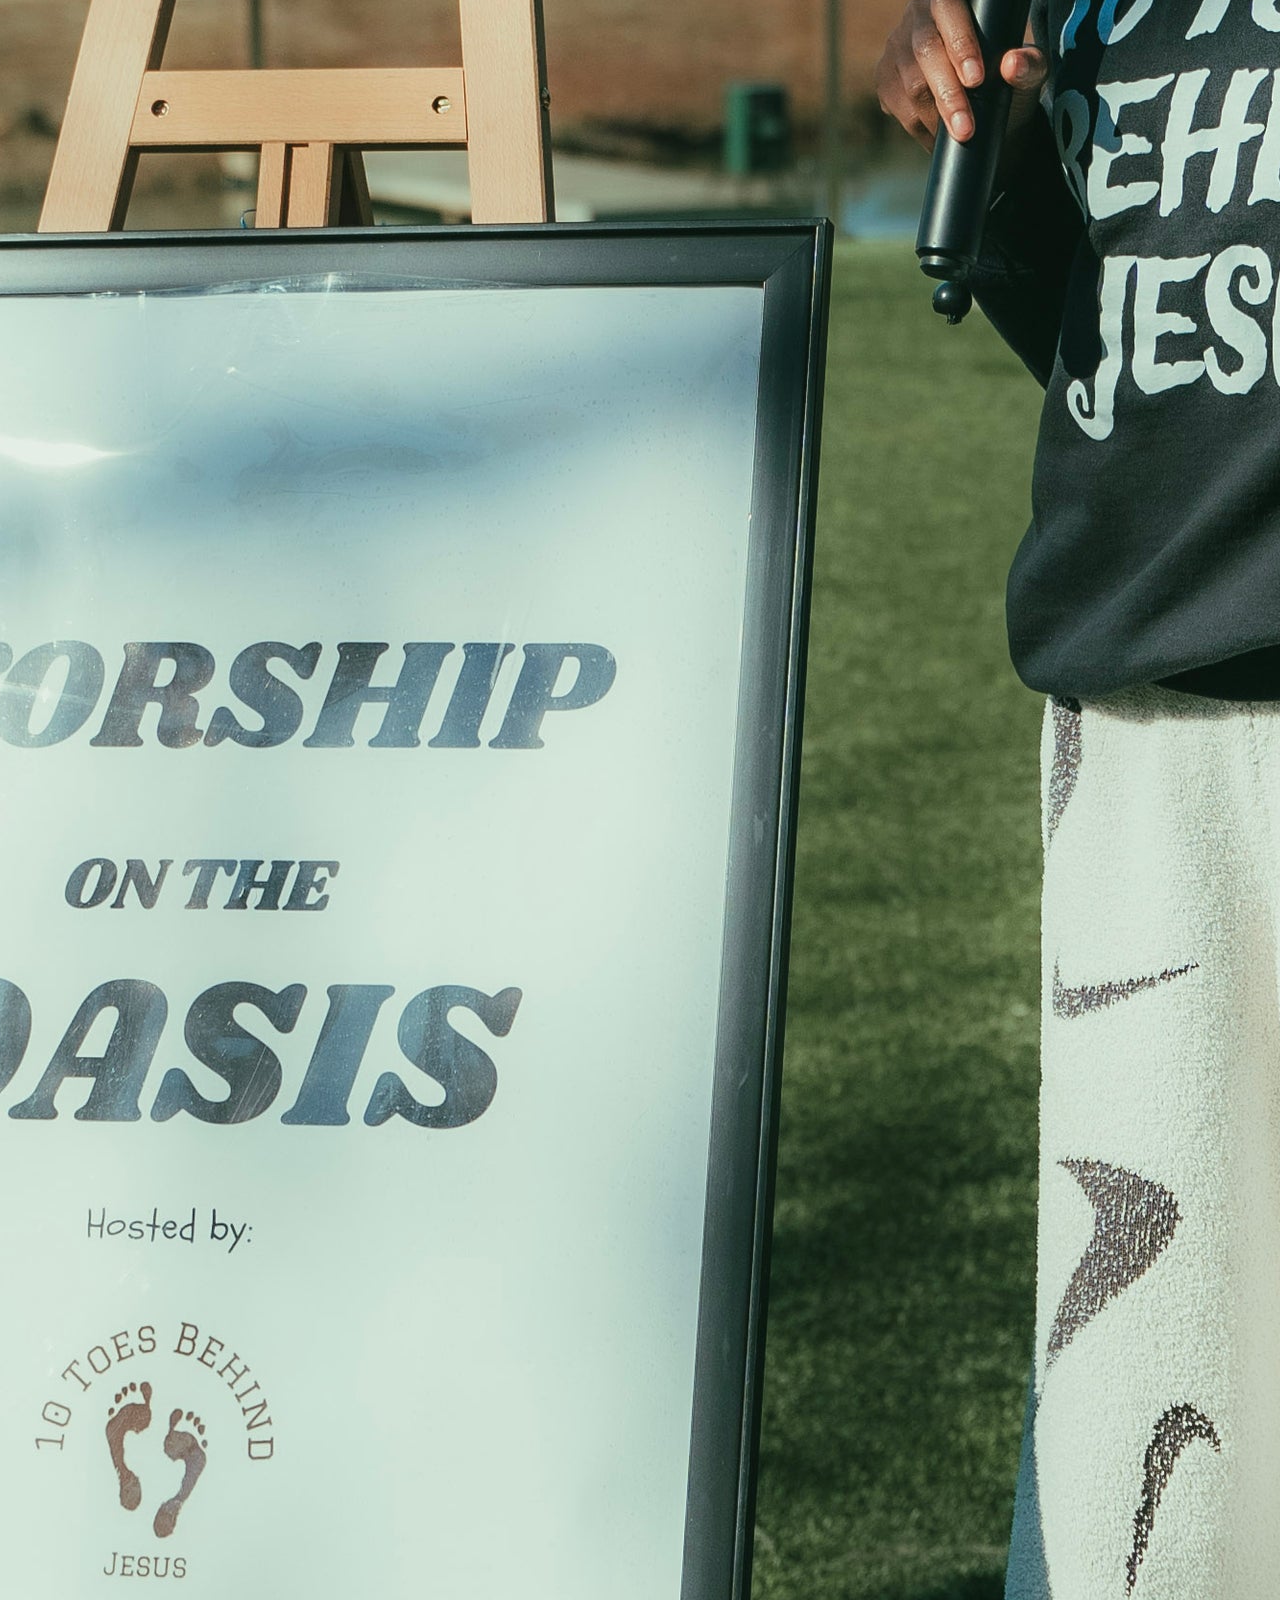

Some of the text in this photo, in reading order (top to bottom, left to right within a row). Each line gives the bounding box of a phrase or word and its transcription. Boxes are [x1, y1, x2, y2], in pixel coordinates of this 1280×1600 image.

[64, 857, 341, 912] ON THE
[86, 1206, 254, 1254] Hosted by:
[35, 1321, 274, 1461] 10 TOES BEHIND
[103, 1551, 188, 1579] JESUS
